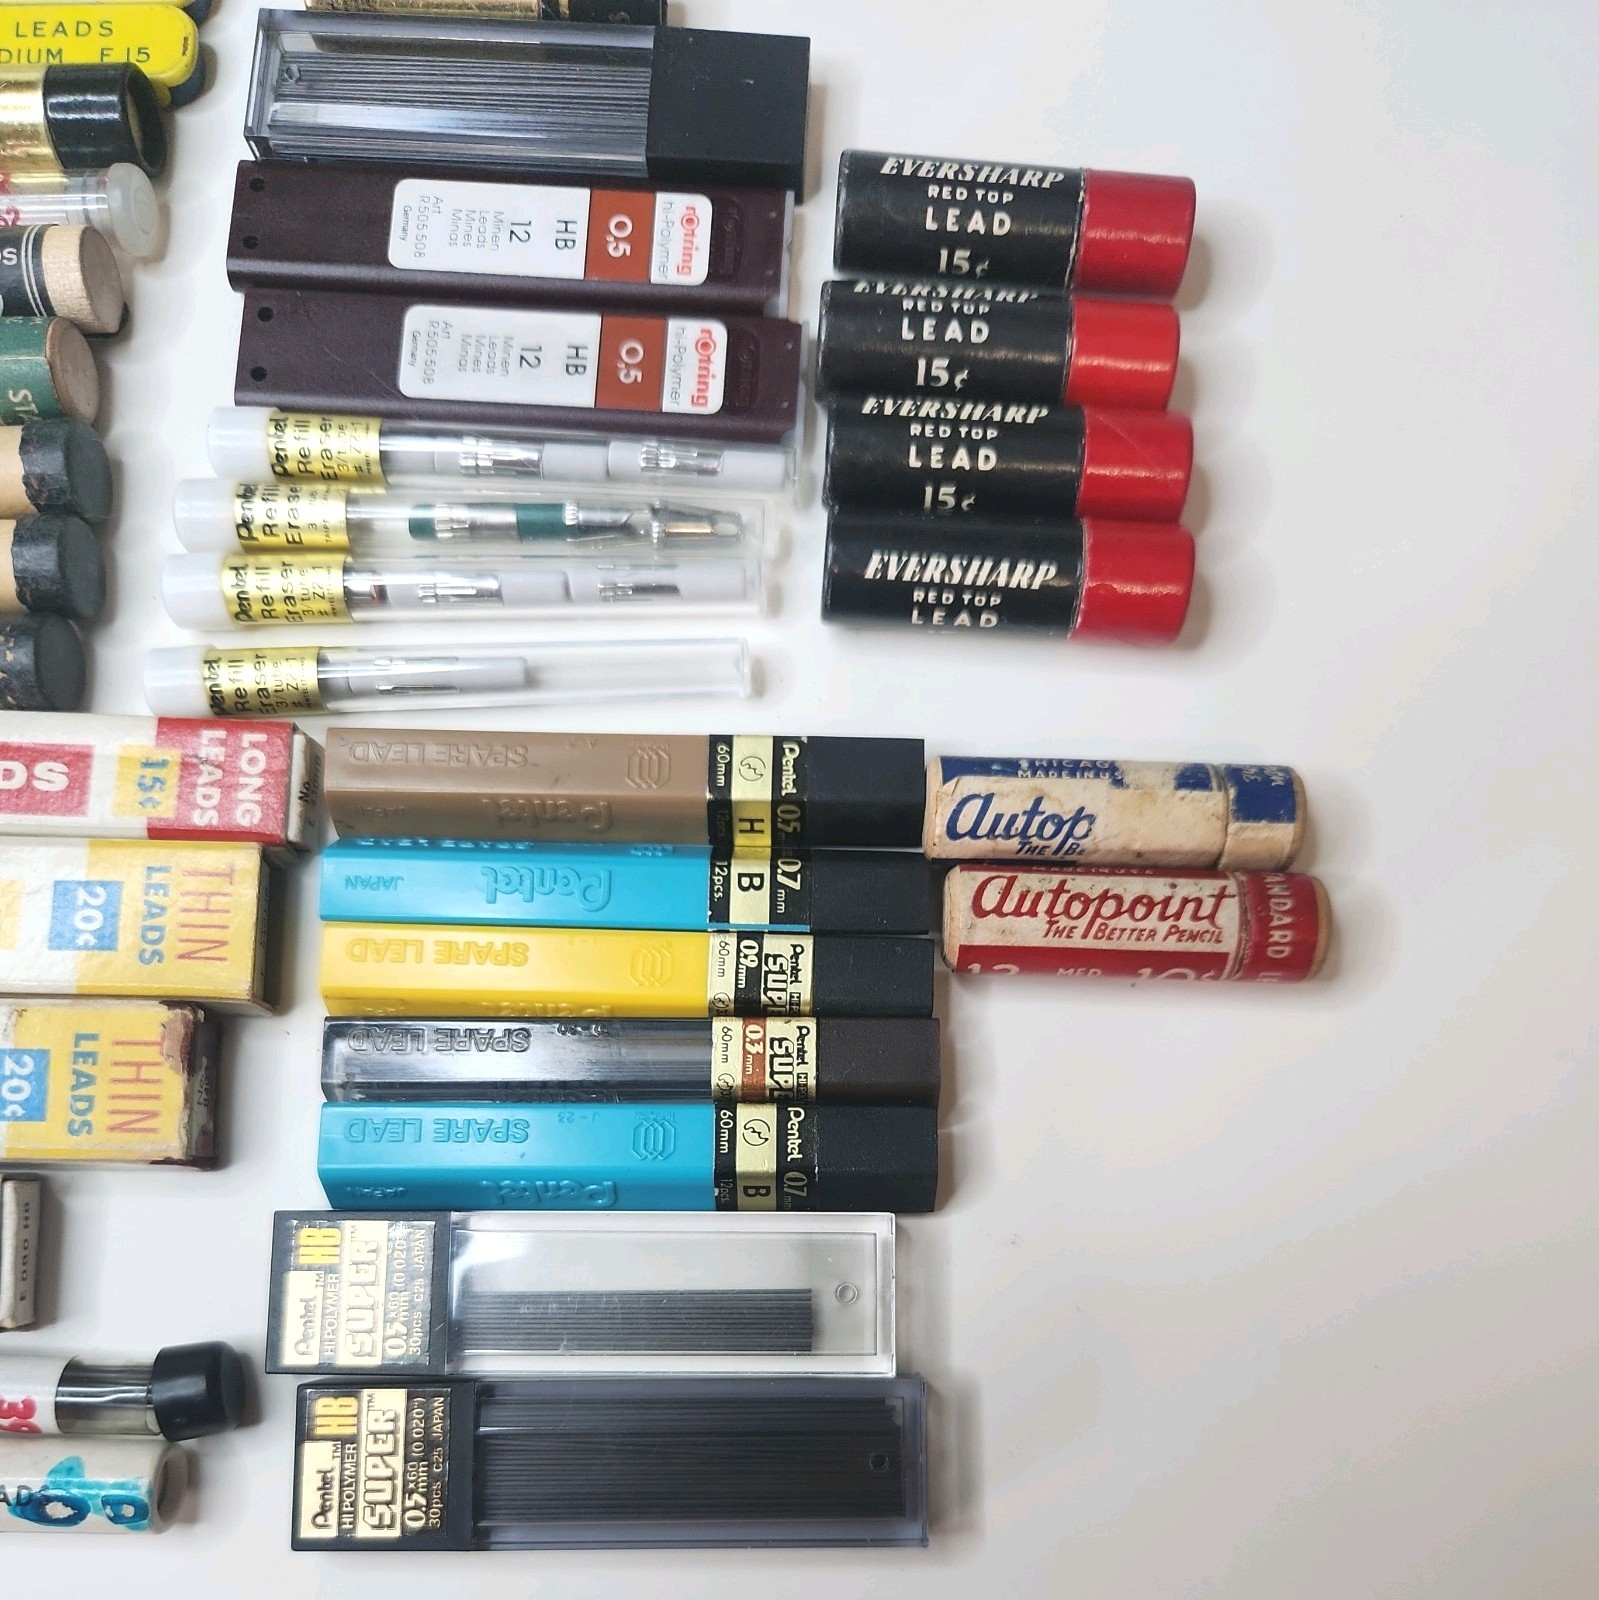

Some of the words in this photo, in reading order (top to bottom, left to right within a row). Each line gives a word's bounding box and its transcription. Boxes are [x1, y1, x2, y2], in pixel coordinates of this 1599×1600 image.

[15, 20, 114, 38] LEADS
[880, 156, 1065, 190] EVERSHARP
[927, 185, 968, 201] RED
[976, 189, 1014, 204] TOP
[399, 205, 413, 243] Germany
[448, 208, 463, 247] Minas
[462, 209, 477, 248] Mines
[476, 209, 490, 250] Leads
[490, 211, 505, 251] Minen
[509, 220, 532, 244] 12
[554, 219, 578, 251] HB
[925, 205, 1012, 237] LEAD
[901, 316, 991, 344] LEAD
[485, 335, 500, 375] Leads
[500, 336, 514, 377] Minen
[519, 344, 543, 370] 12
[565, 344, 589, 377] HB
[861, 397, 1050, 424] EVERSHARP
[268, 416, 296, 478] Pentel
[293, 418, 316, 476] Refill
[319, 415, 340, 482] Eraser
[909, 424, 951, 438] RED
[959, 425, 999, 440] TOP
[907, 443, 998, 472] LEAD
[235, 483, 261, 543] Pentel
[284, 486, 304, 546] Erase
[863, 549, 1058, 591] EVERSHARP
[228, 562, 259, 623] Pentel
[254, 566, 280, 621] Refill
[280, 560, 304, 624] Eraser
[912, 591, 955, 605] RED
[962, 593, 1001, 608] TOP
[911, 609, 999, 629] LEAD
[203, 655, 232, 716] Pentel
[228, 658, 253, 714] Refill
[254, 653, 278, 716] Eraser
[349, 740, 426, 766] LEAD
[434, 740, 529, 768] SPARE
[716, 741, 730, 787] 60mm
[781, 741, 801, 797] Pentel
[192, 728, 229, 827] LEADS
[234, 731, 269, 828] LONG
[1017, 770, 1071, 779] MADE
[1076, 770, 1095, 780] IN
[481, 797, 614, 835] Pentel
[738, 818, 765, 835] H
[1015, 841, 1052, 856] THE
[344, 875, 406, 893] JAPAN
[480, 866, 613, 913] Pentel
[737, 872, 765, 893] B
[72, 886, 108, 949] 20¢
[137, 865, 173, 966] LEADS
[175, 863, 237, 963] THIN
[971, 875, 1237, 940] Autopoint
[345, 937, 424, 965] LEAD
[1042, 918, 1079, 939] THE
[1092, 922, 1158, 944] BETTER
[1161, 924, 1224, 945] PENCIL
[433, 939, 530, 967] SPARE
[717, 940, 731, 978] 60mm
[790, 943, 806, 986] Pentel
[346, 1026, 425, 1053] LEAD
[434, 1026, 532, 1053] SPARE
[720, 1025, 734, 1064] 60mm
[796, 1025, 811, 1067] Pentel
[0, 1053, 35, 1119] 20¢
[66, 1032, 101, 1138] LEADS
[105, 1038, 166, 1135] THIN
[344, 1117, 423, 1144] LEAD
[433, 1117, 531, 1145] SPARE
[719, 1109, 734, 1154] 60mm
[786, 1106, 806, 1162] Pentel
[479, 1178, 619, 1208] Pentel
[742, 1184, 771, 1198] B
[297, 1226, 343, 1265] HB
[412, 1229, 427, 1273] JAPAN
[323, 1273, 341, 1357] HIPOLYMER
[344, 1240, 379, 1358] SUPER
[294, 1296, 318, 1356] Pentel
[409, 1310, 423, 1356] 30pcs
[313, 1396, 359, 1436] HB
[431, 1397, 446, 1441] JAPAN
[341, 1443, 358, 1530] HIPOLYMER
[362, 1409, 398, 1531] SUPER
[311, 1464, 337, 1529] Pentel
[428, 1481, 442, 1529] 30pcs
